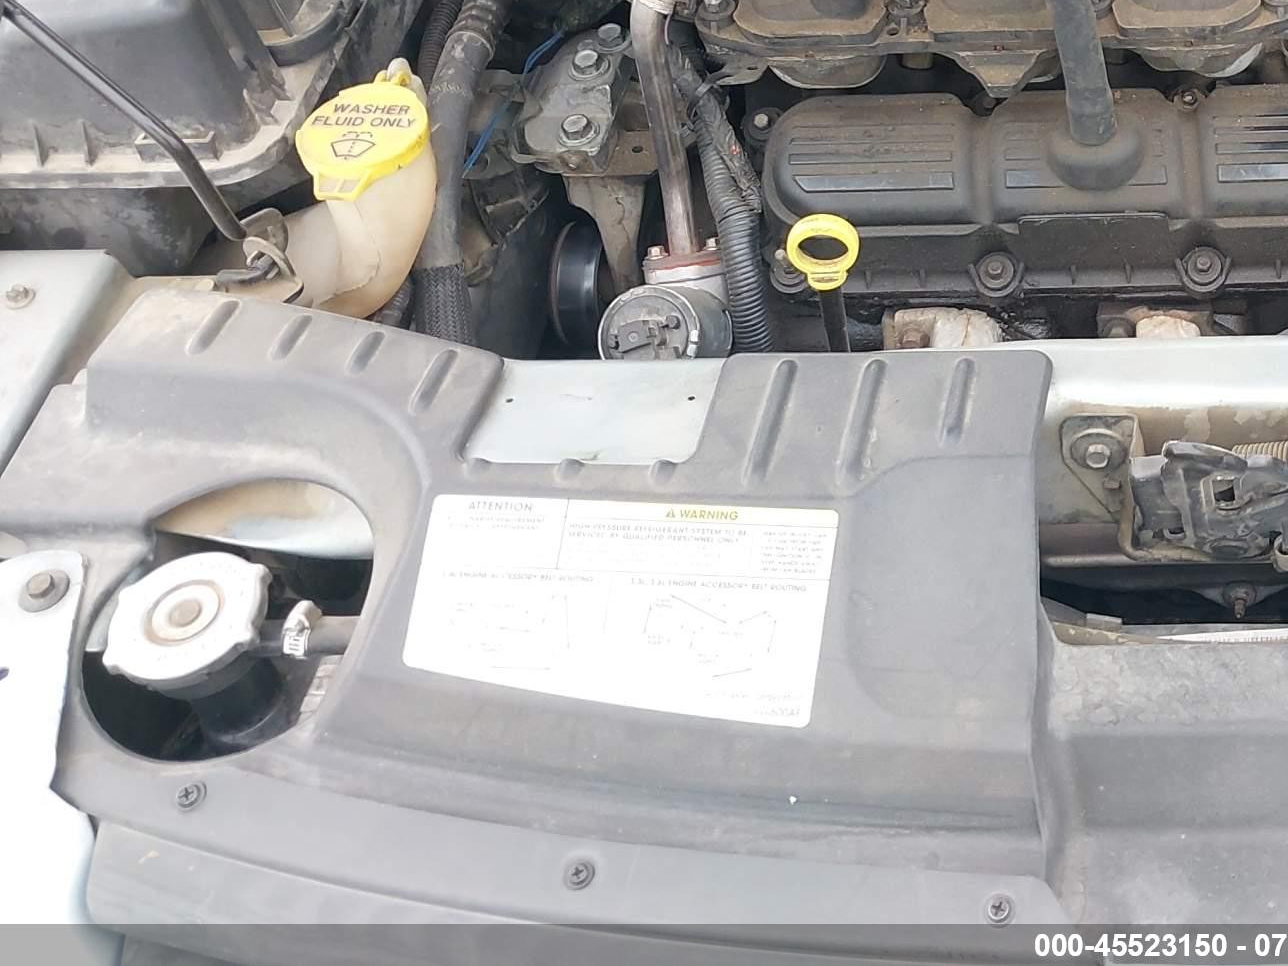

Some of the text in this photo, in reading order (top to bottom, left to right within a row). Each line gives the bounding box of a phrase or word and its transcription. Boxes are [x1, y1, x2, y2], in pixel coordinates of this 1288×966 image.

[332, 103, 411, 116] WASHER
[311, 115, 417, 130] FLUID ONLY
[468, 501, 534, 512] ATTENTION
[679, 510, 739, 521] WARNING
